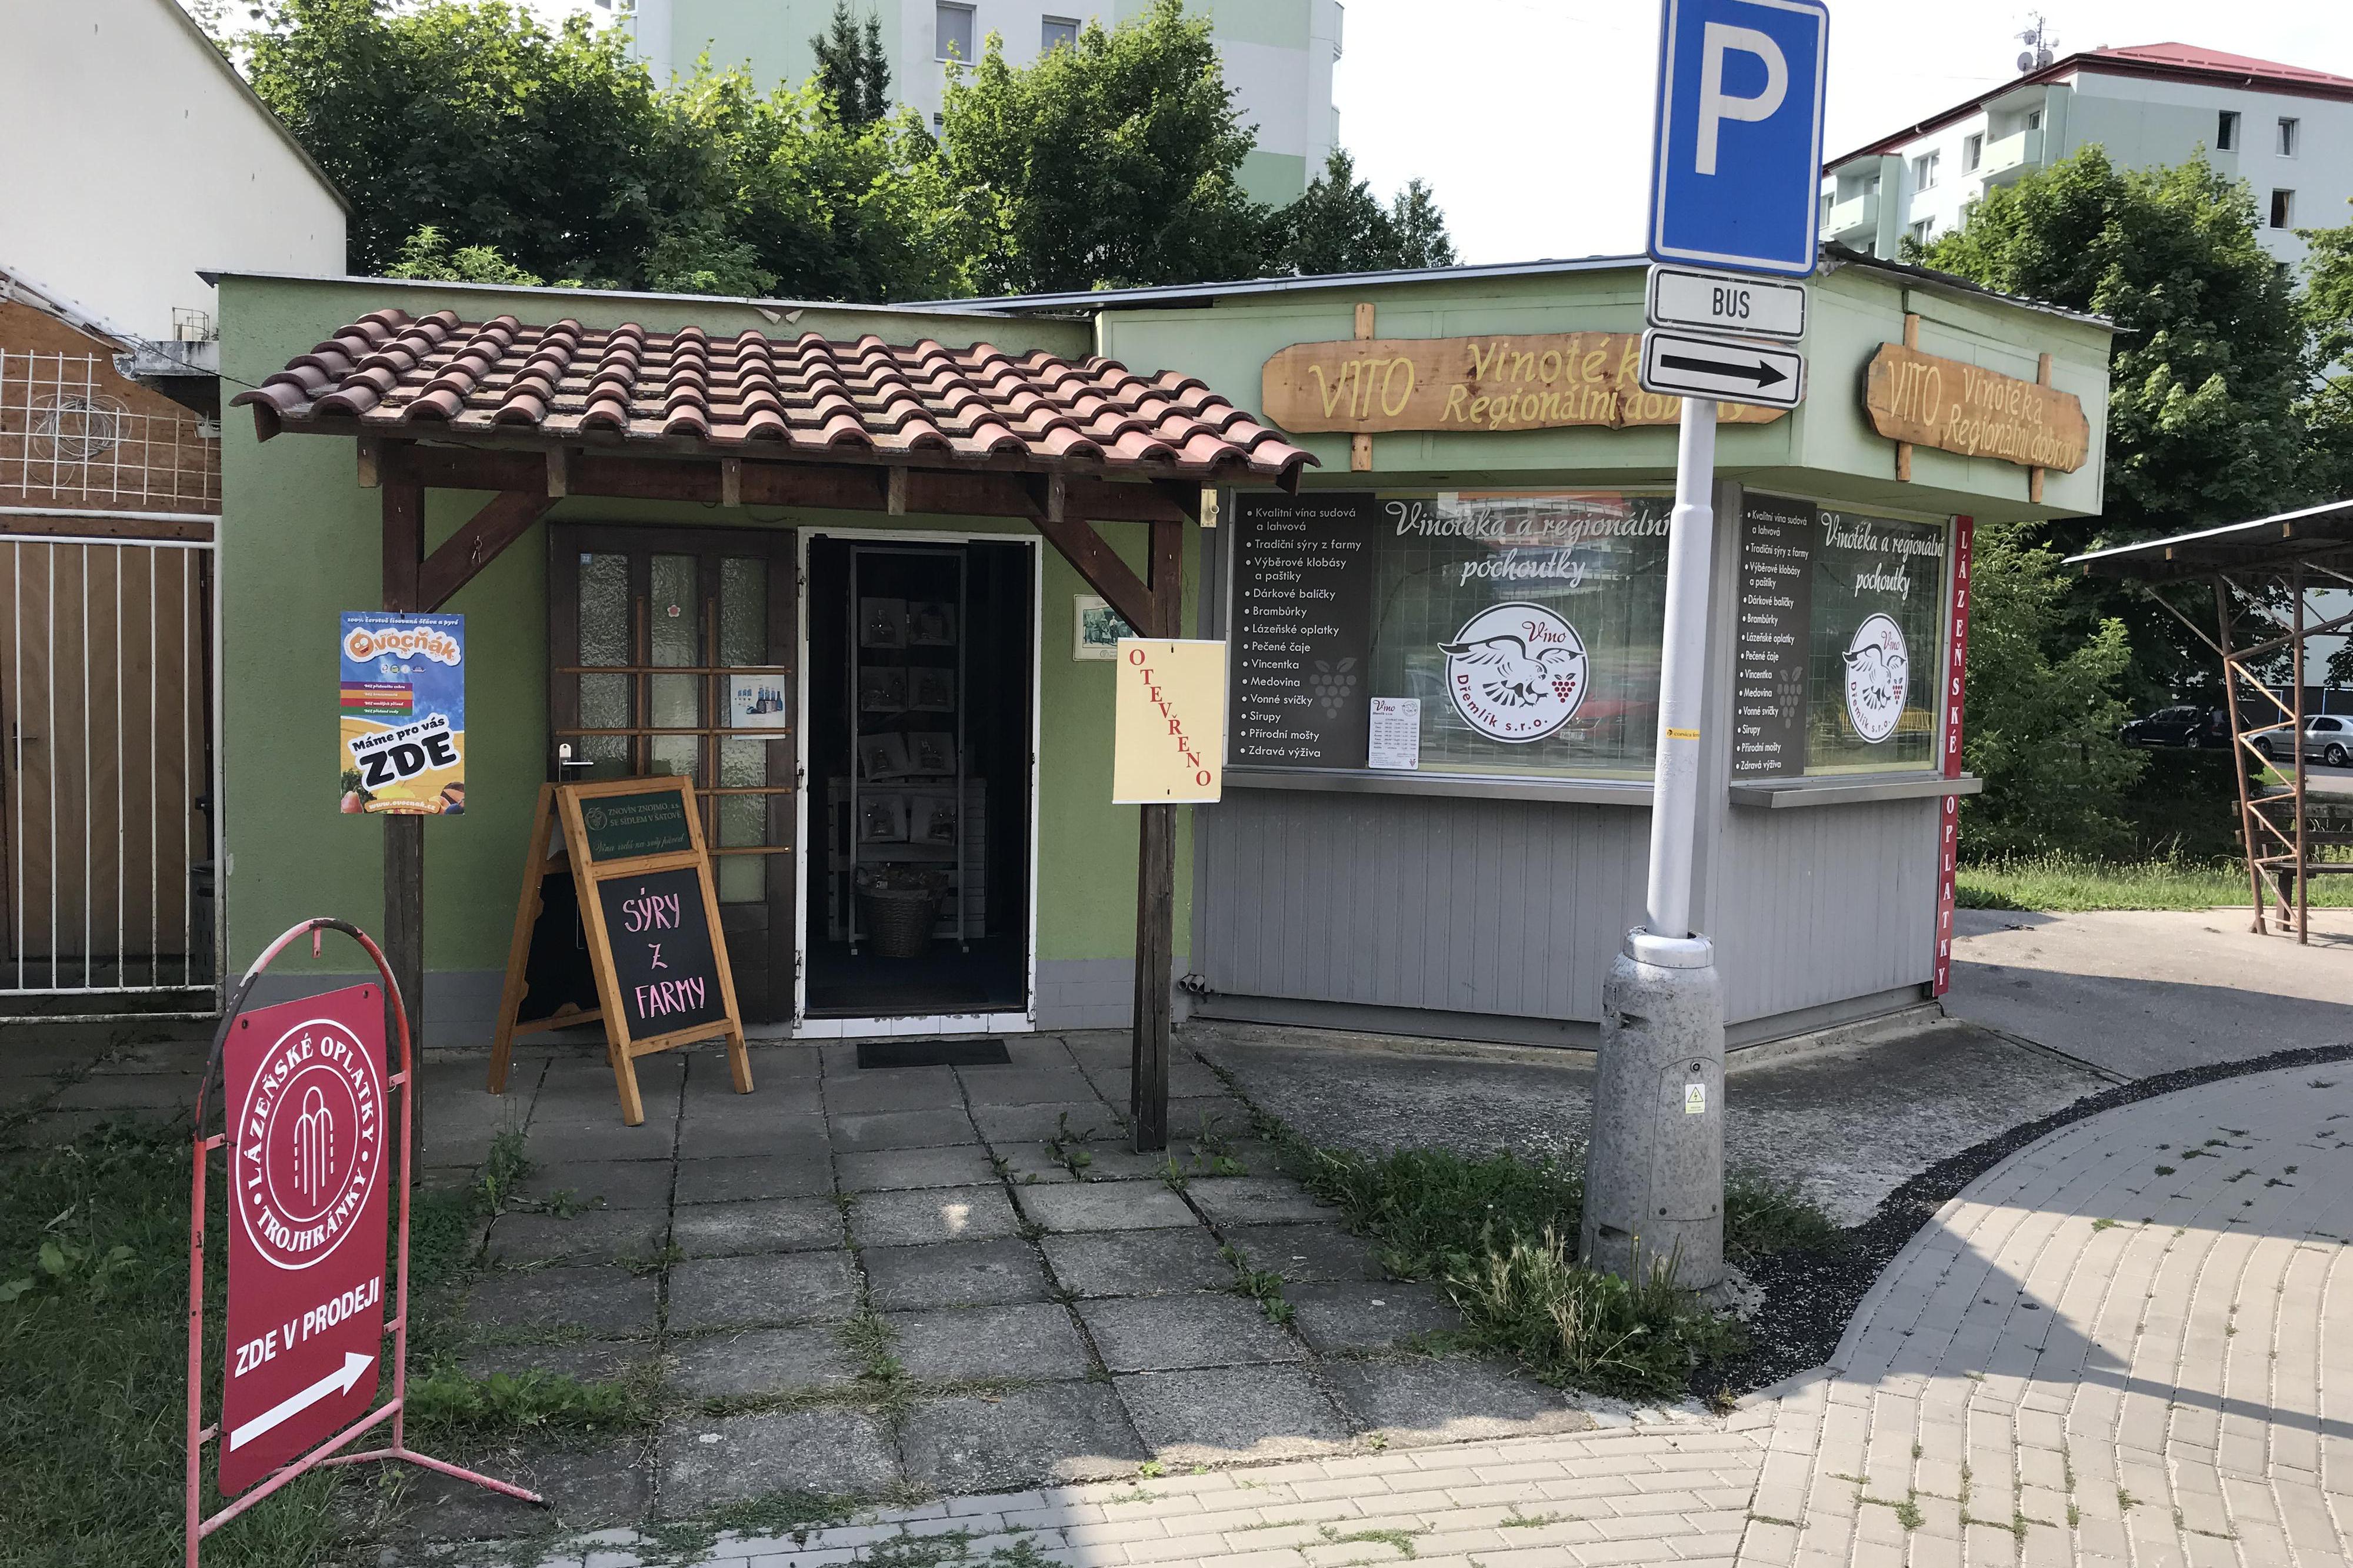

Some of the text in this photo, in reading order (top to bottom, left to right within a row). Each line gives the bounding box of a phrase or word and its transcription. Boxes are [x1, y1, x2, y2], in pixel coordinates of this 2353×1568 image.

[1695, 21, 1788, 175] P
[1712, 287, 1750, 319] BUS
[1309, 357, 1415, 419] VITO
[1888, 361, 1941, 427] VITO
[1439, 384, 1619, 431] Regionální
[1944, 403, 2031, 459] Regionální
[1256, 508, 1356, 518] Kvalitní vína sudová
[1752, 510, 1807, 525] Kvalitní vína sudová
[1267, 522, 1306, 531] lahvová
[1386, 501, 1671, 546] Vinotéka a regionální
[1758, 525, 1780, 536] lahvová
[1821, 512, 1945, 563] Vinotéka a regionální
[1255, 539, 1294, 549] Tradiční
[1297, 540, 1318, 551] sýry
[1331, 539, 1361, 551] farmy
[1751, 543, 1772, 554] Tradiční
[1774, 546, 1786, 558] sýry
[1792, 547, 1809, 560] farmy
[1254, 557, 1347, 569] Výběrové klobásy
[1460, 548, 1586, 588] pochoutky
[1750, 562, 1801, 578] Výběrové klobásy
[1265, 571, 1301, 582] paštiky
[1756, 577, 1776, 590] paštiky
[1855, 562, 1910, 600] pochoutky
[1254, 589, 1336, 601] Dárkové balíčky
[1748, 595, 1794, 609] Dárkové balíčky
[1253, 606, 1307, 618] Brambůrky
[1747, 613, 1778, 626] Brambůrky
[1252, 624, 1339, 636] Lázeňské oplatky
[1522, 621, 1567, 643] Víno
[349, 631, 456, 660] Ovocňák
[1747, 632, 1795, 645] Lázeňské oplatky
[1949, 531, 1968, 753] LÁZEŇSKÉ
[1252, 642, 1311, 653] Pečené čaje
[1746, 650, 1779, 663] Pečené čaje
[1252, 659, 1299, 669] Vincentka
[1745, 669, 1772, 679] Vincentka
[1251, 676, 1300, 687] Medovina
[1744, 688, 1772, 697] Medovina
[1250, 694, 1312, 707] Vonné svíčky
[1457, 675, 1548, 731] Dřemlík s.r.o.
[1129, 649, 1211, 786] OTEVŘENO
[1249, 711, 1281, 723] Sirupy
[1743, 706, 1778, 718] Vonné svíčky
[352, 717, 445, 752] Máme pro vás
[1249, 728, 1319, 742] Přírodní mošty
[1742, 724, 1761, 736] Sirupy
[1249, 746, 1321, 759] Zdravá výživa
[1742, 742, 1781, 753] Přírodní mošty
[359, 731, 456, 787] ZDE
[1741, 760, 1781, 771] Zdravá výživa
[368, 800, 436, 810] www.ovocnak.cz
[1938, 795, 1954, 985] OPLATKY
[622, 888, 680, 932] SÝRY
[634, 976, 705, 1019] FARMY
[244, 1032, 374, 1190] LÁZEŇSKÉ OPLATKY
[256, 1167, 366, 1253] TROJHRÁNKY
[235, 1277, 380, 1379] ZDE V PRODEJI
